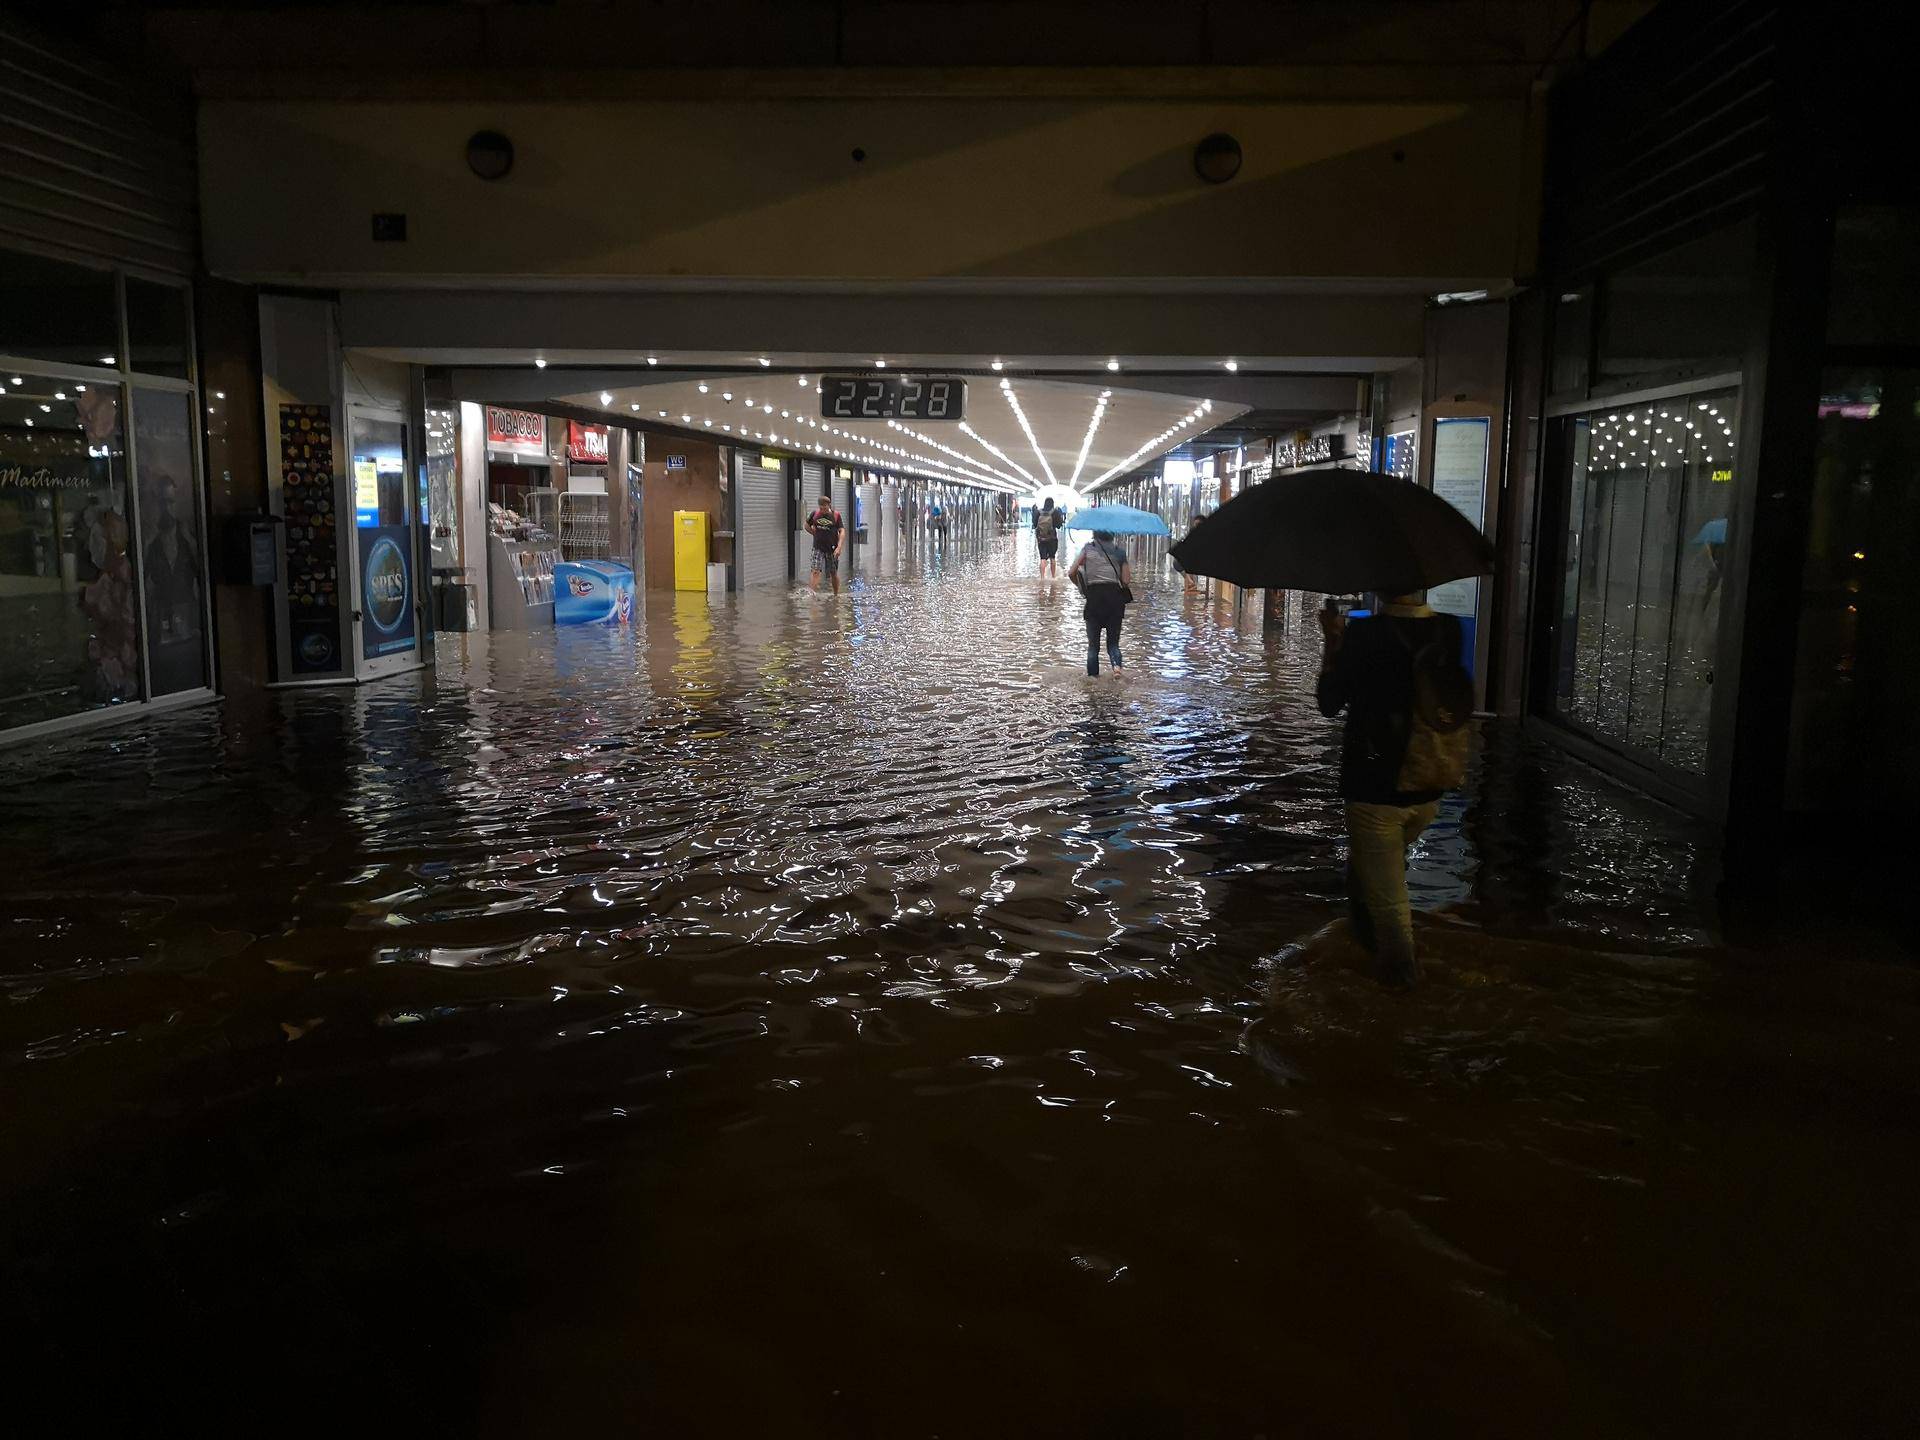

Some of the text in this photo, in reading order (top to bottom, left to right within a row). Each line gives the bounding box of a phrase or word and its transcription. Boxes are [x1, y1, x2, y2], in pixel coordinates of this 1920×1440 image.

[834, 381, 950, 416] 22:28
[490, 409, 540, 439] TOBACCO
[670, 456, 683, 464] WC
